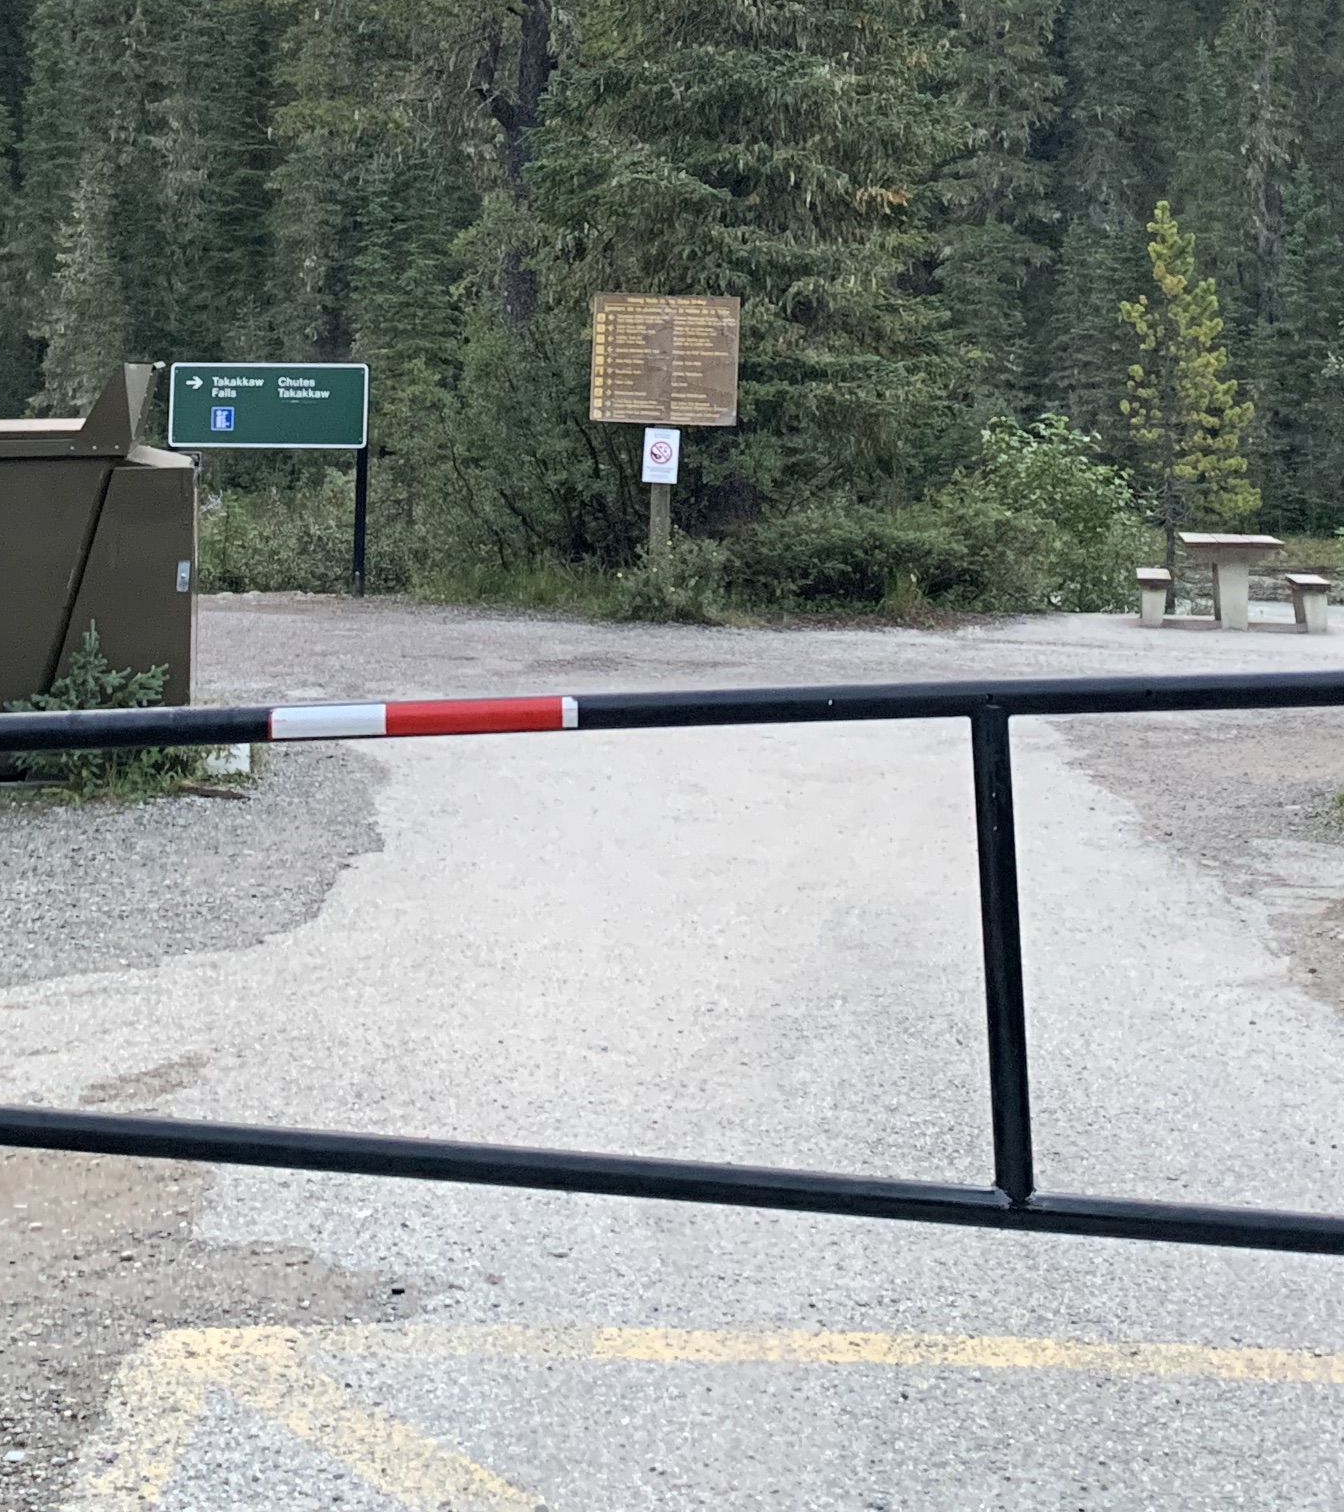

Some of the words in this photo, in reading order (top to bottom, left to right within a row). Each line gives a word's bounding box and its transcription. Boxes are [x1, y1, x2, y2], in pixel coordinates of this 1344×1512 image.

[212, 377, 264, 387] Takakkaw
[278, 377, 316, 387] Chutes
[212, 388, 237, 398] Falls
[278, 388, 330, 398] Takakkaw
